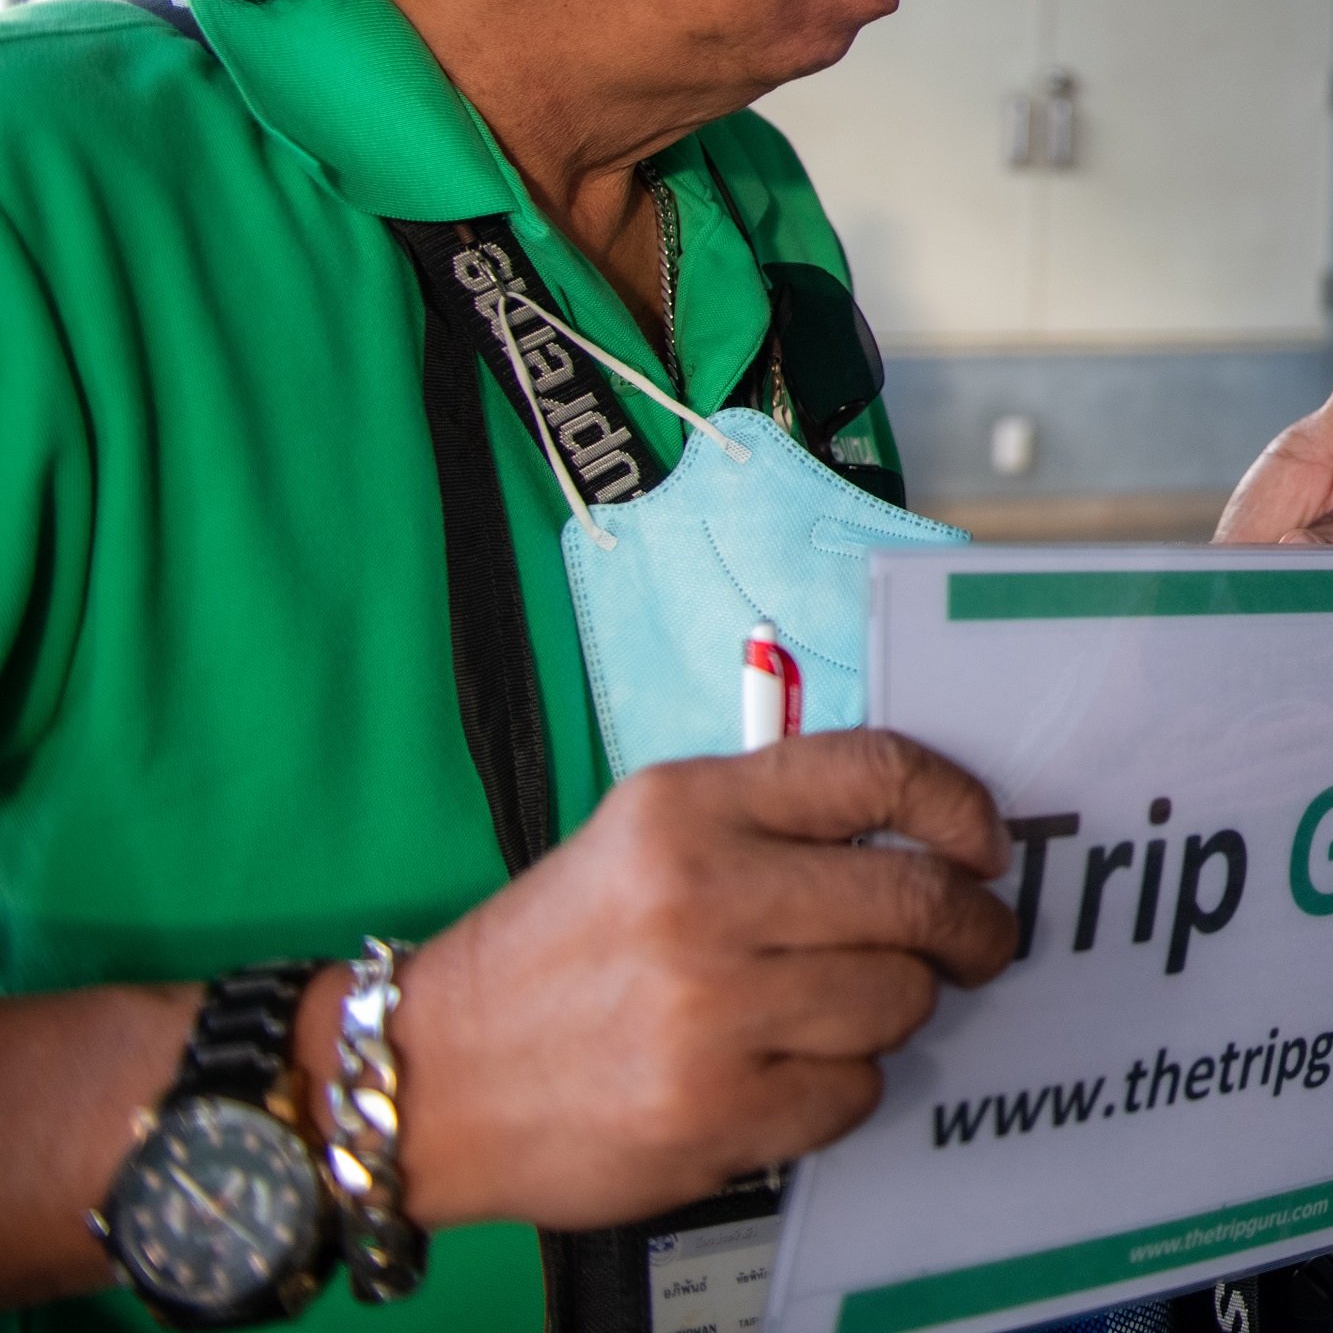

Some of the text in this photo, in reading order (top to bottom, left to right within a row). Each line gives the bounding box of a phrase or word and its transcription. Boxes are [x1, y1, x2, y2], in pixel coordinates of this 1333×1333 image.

[452, 241, 647, 504] upreme
[1004, 796, 1248, 975] Trip
[1128, 1195, 1329, 1263] www.thetripguru.com
